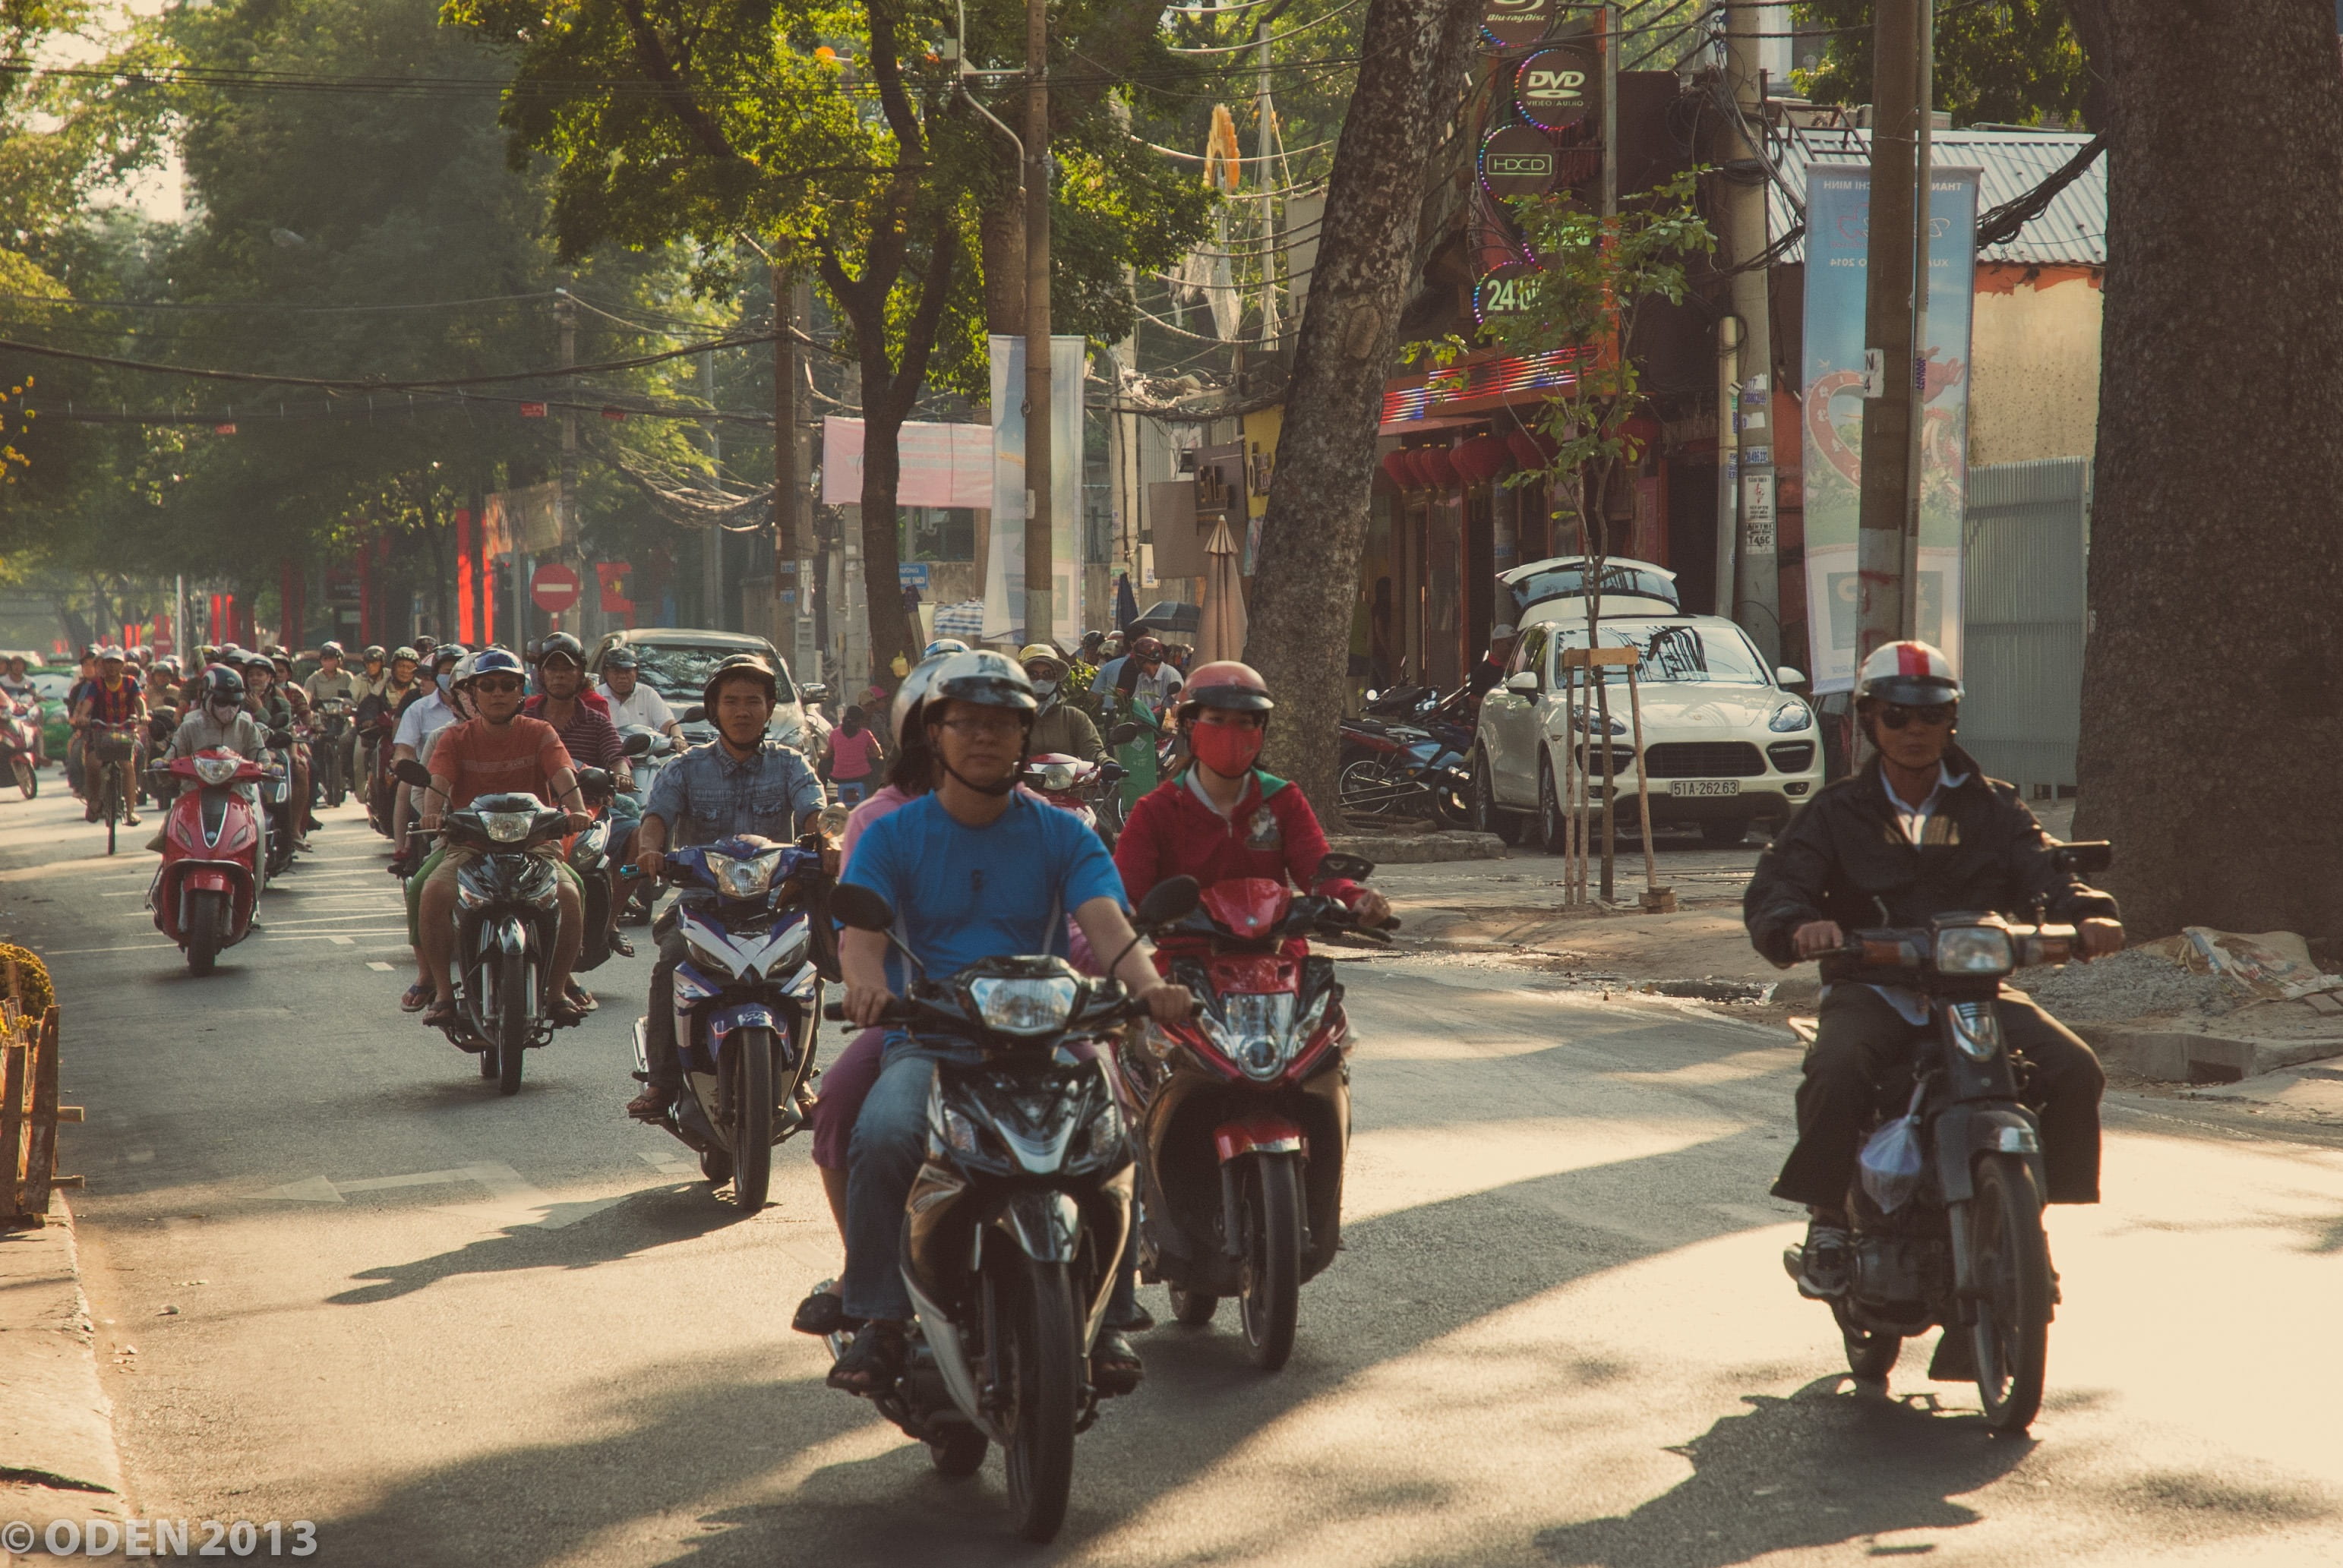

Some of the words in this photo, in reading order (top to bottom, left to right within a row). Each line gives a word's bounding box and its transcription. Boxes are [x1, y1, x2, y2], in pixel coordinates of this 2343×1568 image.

[1528, 71, 1586, 90] DVD
[1494, 159, 1546, 171] HDCD
[1674, 782, 1737, 795] 51A-262.63
